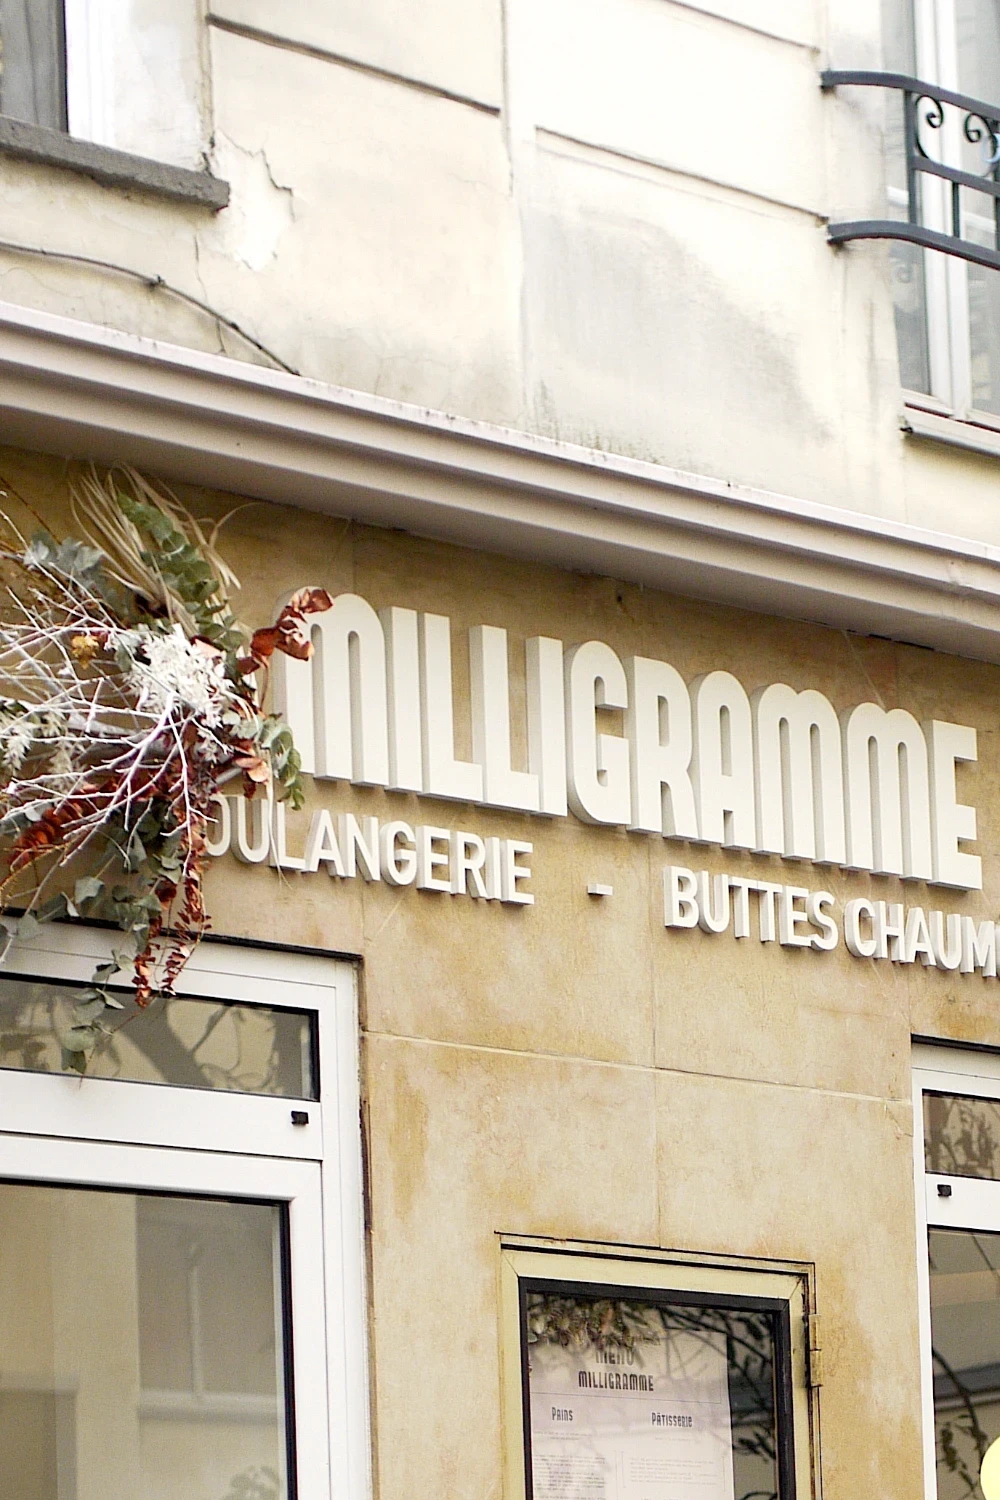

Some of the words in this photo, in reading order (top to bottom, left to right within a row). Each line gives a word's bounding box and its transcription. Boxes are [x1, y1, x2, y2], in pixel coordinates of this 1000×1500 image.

[273, 586, 982, 890] MILLIGRAMME
[203, 794, 534, 905] OULANGERIE
[664, 866, 839, 951] BUTTES
[578, 1370, 655, 1392] MILLIGRAMME
